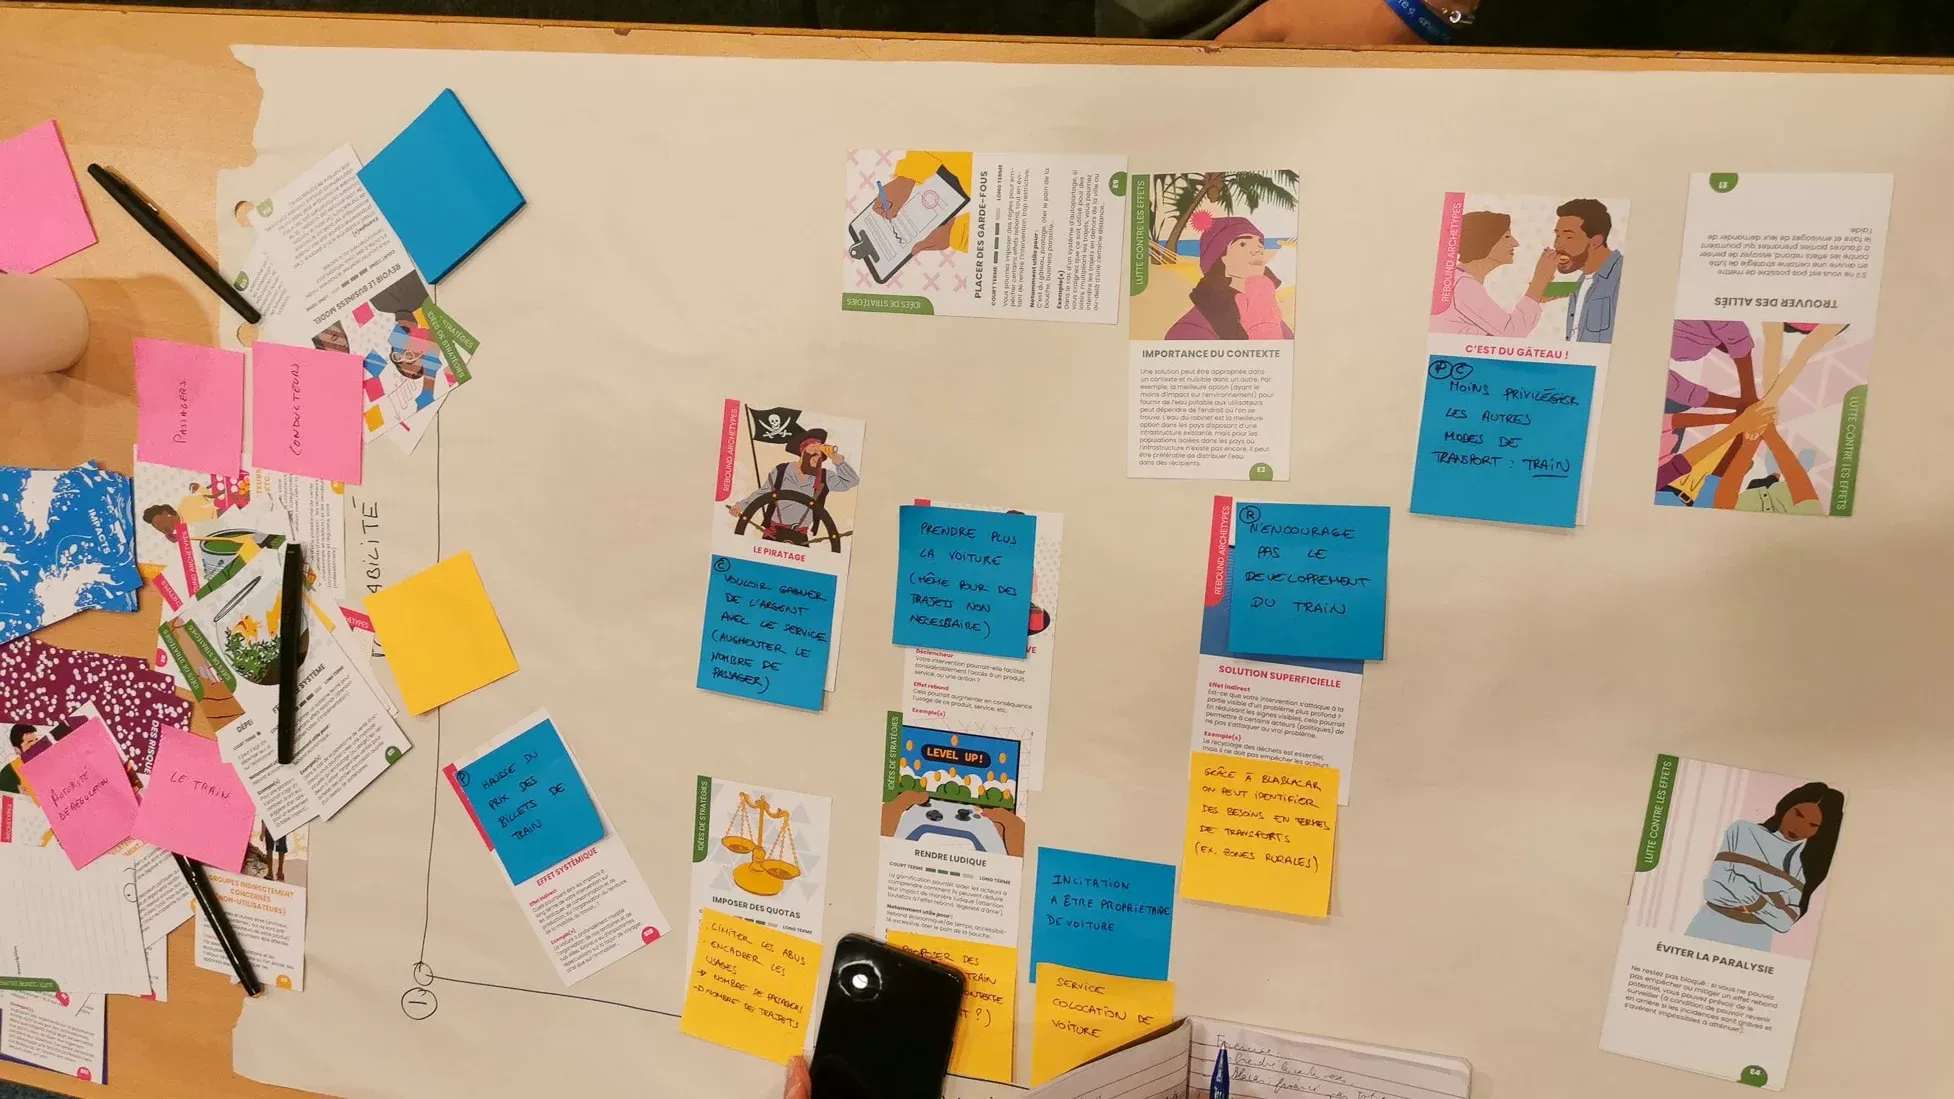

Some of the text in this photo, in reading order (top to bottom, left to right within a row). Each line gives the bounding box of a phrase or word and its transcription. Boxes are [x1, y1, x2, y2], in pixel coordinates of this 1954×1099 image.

[974, 171, 987, 298] PLACER DES GARDE-FOUS
[1135, 179, 1144, 284] LUTTE CONTRE LES EFFETS
[1441, 202, 1462, 303] REBOUND ARCHETYPES
[312, 262, 402, 326] REVOIR LE BUSINESS MODEL
[845, 298, 888, 307] STRATÉGIES
[1714, 297, 1838, 308] TROUVER DES ALLIÉS
[901, 300, 921, 310] IDÉES
[1141, 349, 1208, 358] IMPORTANCE
[1226, 349, 1280, 358] CONTEXTE
[1498, 346, 1514, 355] DU
[1516, 348, 1562, 359] GÂTEAU
[1449, 380, 1490, 396] MOINS
[1445, 407, 1531, 425] LES AUTRES
[1444, 431, 1522, 448] MODES DE
[723, 408, 738, 492] REBOUND ARCHETYPES
[1836, 396, 1858, 510] LUTTE CONTRE LES EFFETS
[1431, 451, 1570, 472] TRANSPORT TRAIN
[88, 508, 110, 554] IMPACTS
[920, 522, 1016, 545] PRENDRE PLUS
[352, 497, 381, 594] ABILITÉ
[753, 546, 805, 562] LE PIRATAGE
[1214, 505, 1230, 595] REBOUND ARCHETYPES
[1256, 546, 1327, 559] PAS LE
[919, 548, 1002, 565] LA VOITURE
[724, 574, 772, 590] VOULOIR
[909, 572, 1017, 596] (MÊME POUR DES
[725, 592, 742, 604] DE
[910, 593, 954, 608] TRAJETS
[1250, 595, 1346, 615] DU TRAIN
[720, 611, 827, 642] AVEC LE SERVICE
[710, 651, 781, 671] NOMBRE DE
[794, 646, 811, 658] LE
[916, 648, 954, 658] Déclencheur
[1218, 665, 1341, 688] SOLUTION SUPERFICIELLE
[1223, 683, 1250, 692] indirect
[1204, 730, 1241, 742] Exemple(s)
[523, 751, 538, 764] DU
[887, 715, 899, 791] IDÉES DE STRATÉGIES
[926, 747, 983, 763] LEVEL UP!
[169, 771, 230, 800] LE TRAIN
[488, 775, 537, 810] PRIX DES
[1261, 774, 1321, 792] BLABLACAR
[498, 782, 565, 828] BILLETS DE
[1221, 786, 1248, 797] PEUT
[1254, 790, 1319, 808] IDENTIFIER
[1201, 804, 1218, 814] DES
[1226, 807, 1264, 820] BESOINS
[1273, 814, 1290, 823] EN
[1644, 760, 1672, 863] LUTTE CONTRE LES EFFETS
[511, 819, 542, 840] TRAIN
[1199, 824, 1290, 843] DE TRANSPORTS
[914, 849, 986, 867] RENDRE LUDIQUE
[1265, 852, 1318, 872] RURALES)
[536, 872, 555, 886] EFFET
[1052, 874, 1130, 890] INCITATION
[712, 896, 800, 919] IMPOSER DES QUOTAS
[1063, 894, 1093, 908] ÊTRE
[1046, 914, 1114, 931] DE VOITURE
[711, 922, 805, 966] LIMITER LES ABUS
[705, 955, 736, 975] USAGES
[710, 940, 785, 976] ENCADRER LES
[962, 954, 978, 966] DES
[1656, 941, 1774, 974] ÉVITER LA PARALYSIE
[965, 972, 996, 985] TRAIN
[1056, 977, 1105, 994] SERVICE
[705, 989, 799, 1028] NOMBRE DE TRAJETS
[1052, 998, 1154, 1025] COLOCATION DE
[1051, 1019, 1101, 1038] VOITURE
